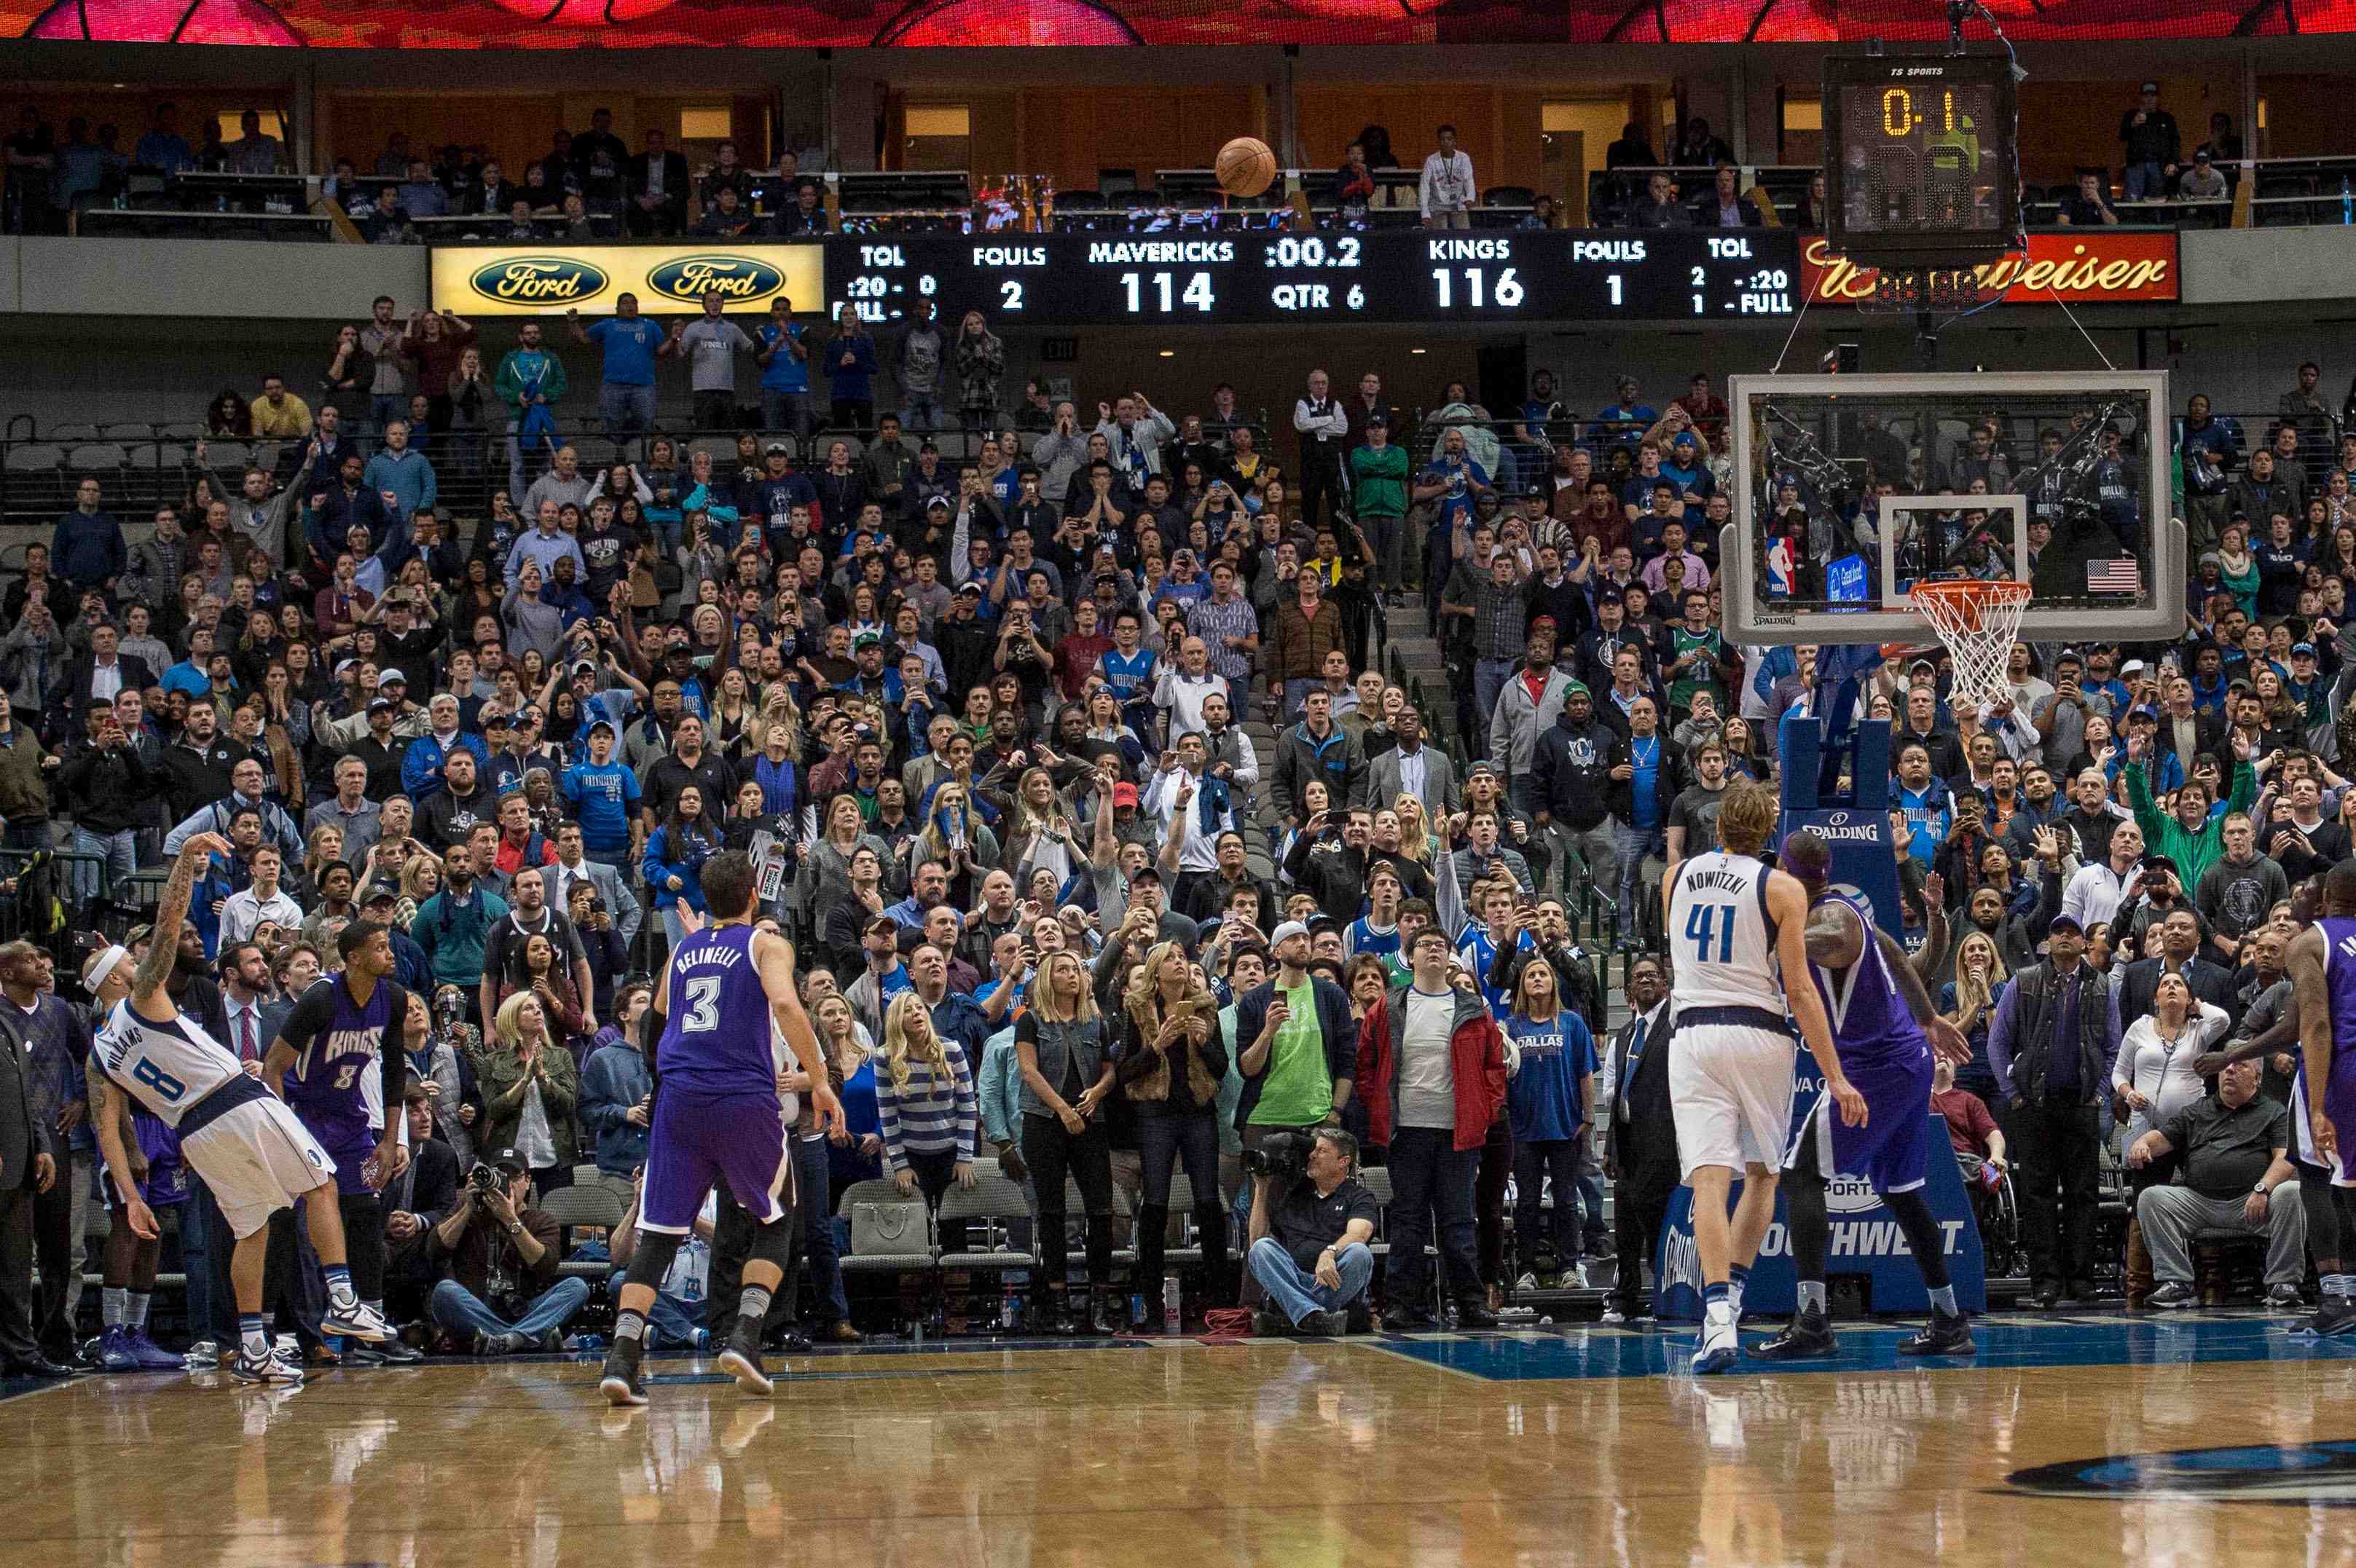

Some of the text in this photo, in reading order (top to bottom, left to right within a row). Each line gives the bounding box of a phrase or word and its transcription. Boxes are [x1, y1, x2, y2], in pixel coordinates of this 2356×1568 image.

[1890, 67, 1944, 76] TS SPORTS
[860, 245, 906, 267] TOL
[973, 248, 1045, 266] FOULS
[1089, 242, 1233, 262] MAVERICKS
[1265, 237, 1360, 267] :00.2
[1429, 240, 1509, 260] KINGS
[1573, 240, 1646, 261] FOULS
[1708, 238, 1752, 258] TOL
[498, 263, 579, 297] Ford
[673, 263, 757, 296] Ford
[847, 275, 887, 297] :20
[919, 275, 936, 295] 0
[1433, 268, 1524, 307] 116
[1606, 275, 1622, 305] 1
[1691, 267, 1705, 286] 2
[1750, 270, 1788, 289] :20
[1001, 281, 1023, 310] 2
[1120, 272, 1214, 312] 114
[1272, 285, 1364, 310] QTR 6
[1693, 294, 1703, 313] 1
[1741, 293, 1793, 313] FULL
[833, 301, 887, 322] FLL
[1771, 583, 1786, 592] NBA
[1753, 616, 1796, 626] SPALDING
[763, 869, 774, 894] ACME
[1686, 870, 1748, 895] NOWITZKI
[1684, 902, 1737, 965] 41
[676, 946, 742, 974] BELINELLI
[682, 975, 720, 1033] 3
[325, 1025, 385, 1064] KINGS
[1516, 1036, 1564, 1049] DALLAS
[133, 1055, 187, 1108] 8
[333, 1065, 358, 1090] 8
[1823, 1180, 1880, 1197] PORT
[1759, 1221, 1964, 1257] OHWET
[1662, 1224, 1703, 1298] SPALDIN
